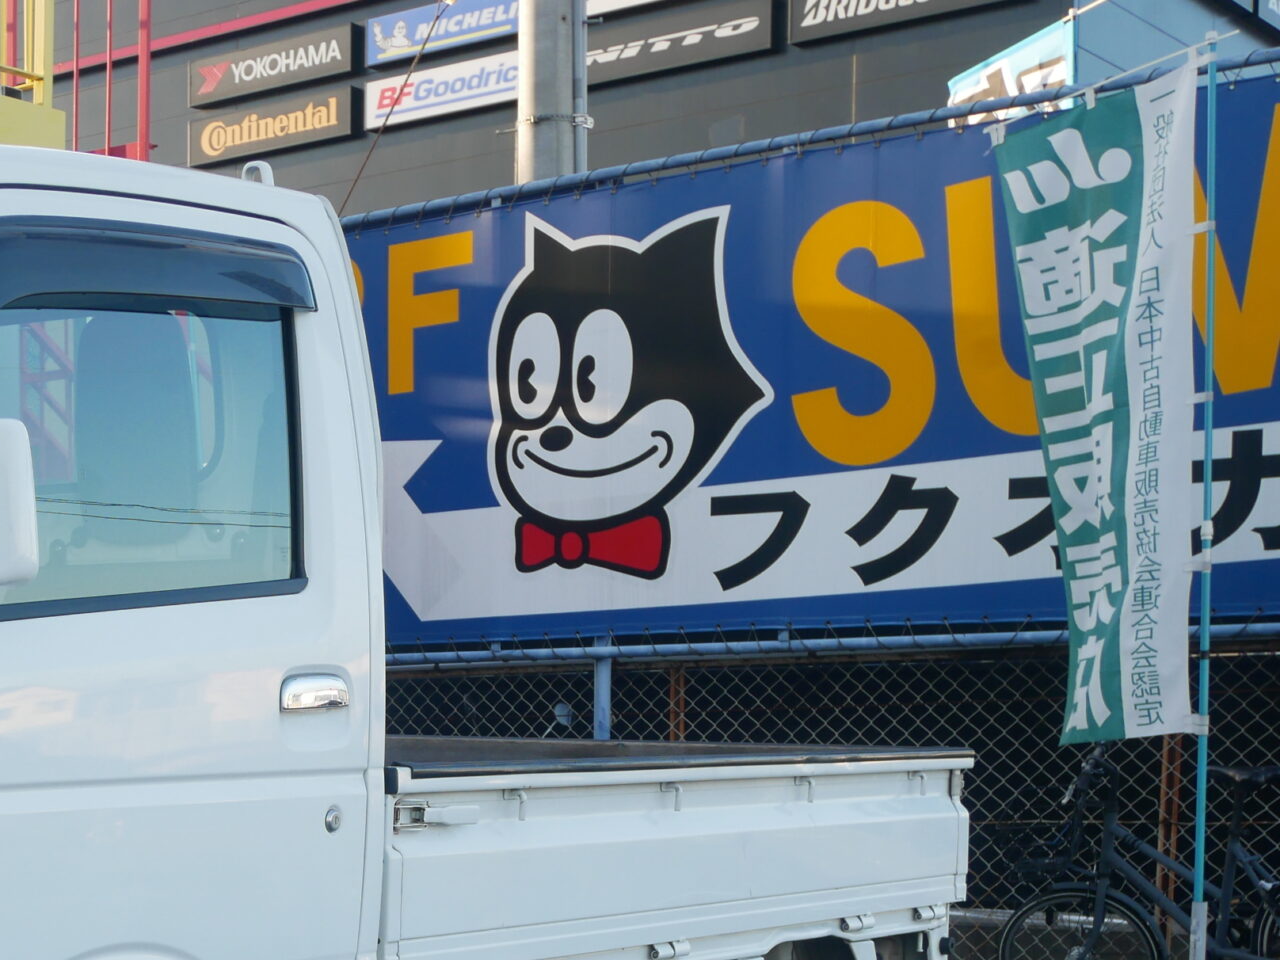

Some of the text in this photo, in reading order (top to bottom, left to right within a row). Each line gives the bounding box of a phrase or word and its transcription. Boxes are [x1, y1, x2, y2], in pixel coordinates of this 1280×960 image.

[415, 1, 519, 41] MICHELI
[586, 16, 760, 67] NITTO
[231, 39, 342, 83] YOKOHAMA
[201, 97, 338, 156] Continental
